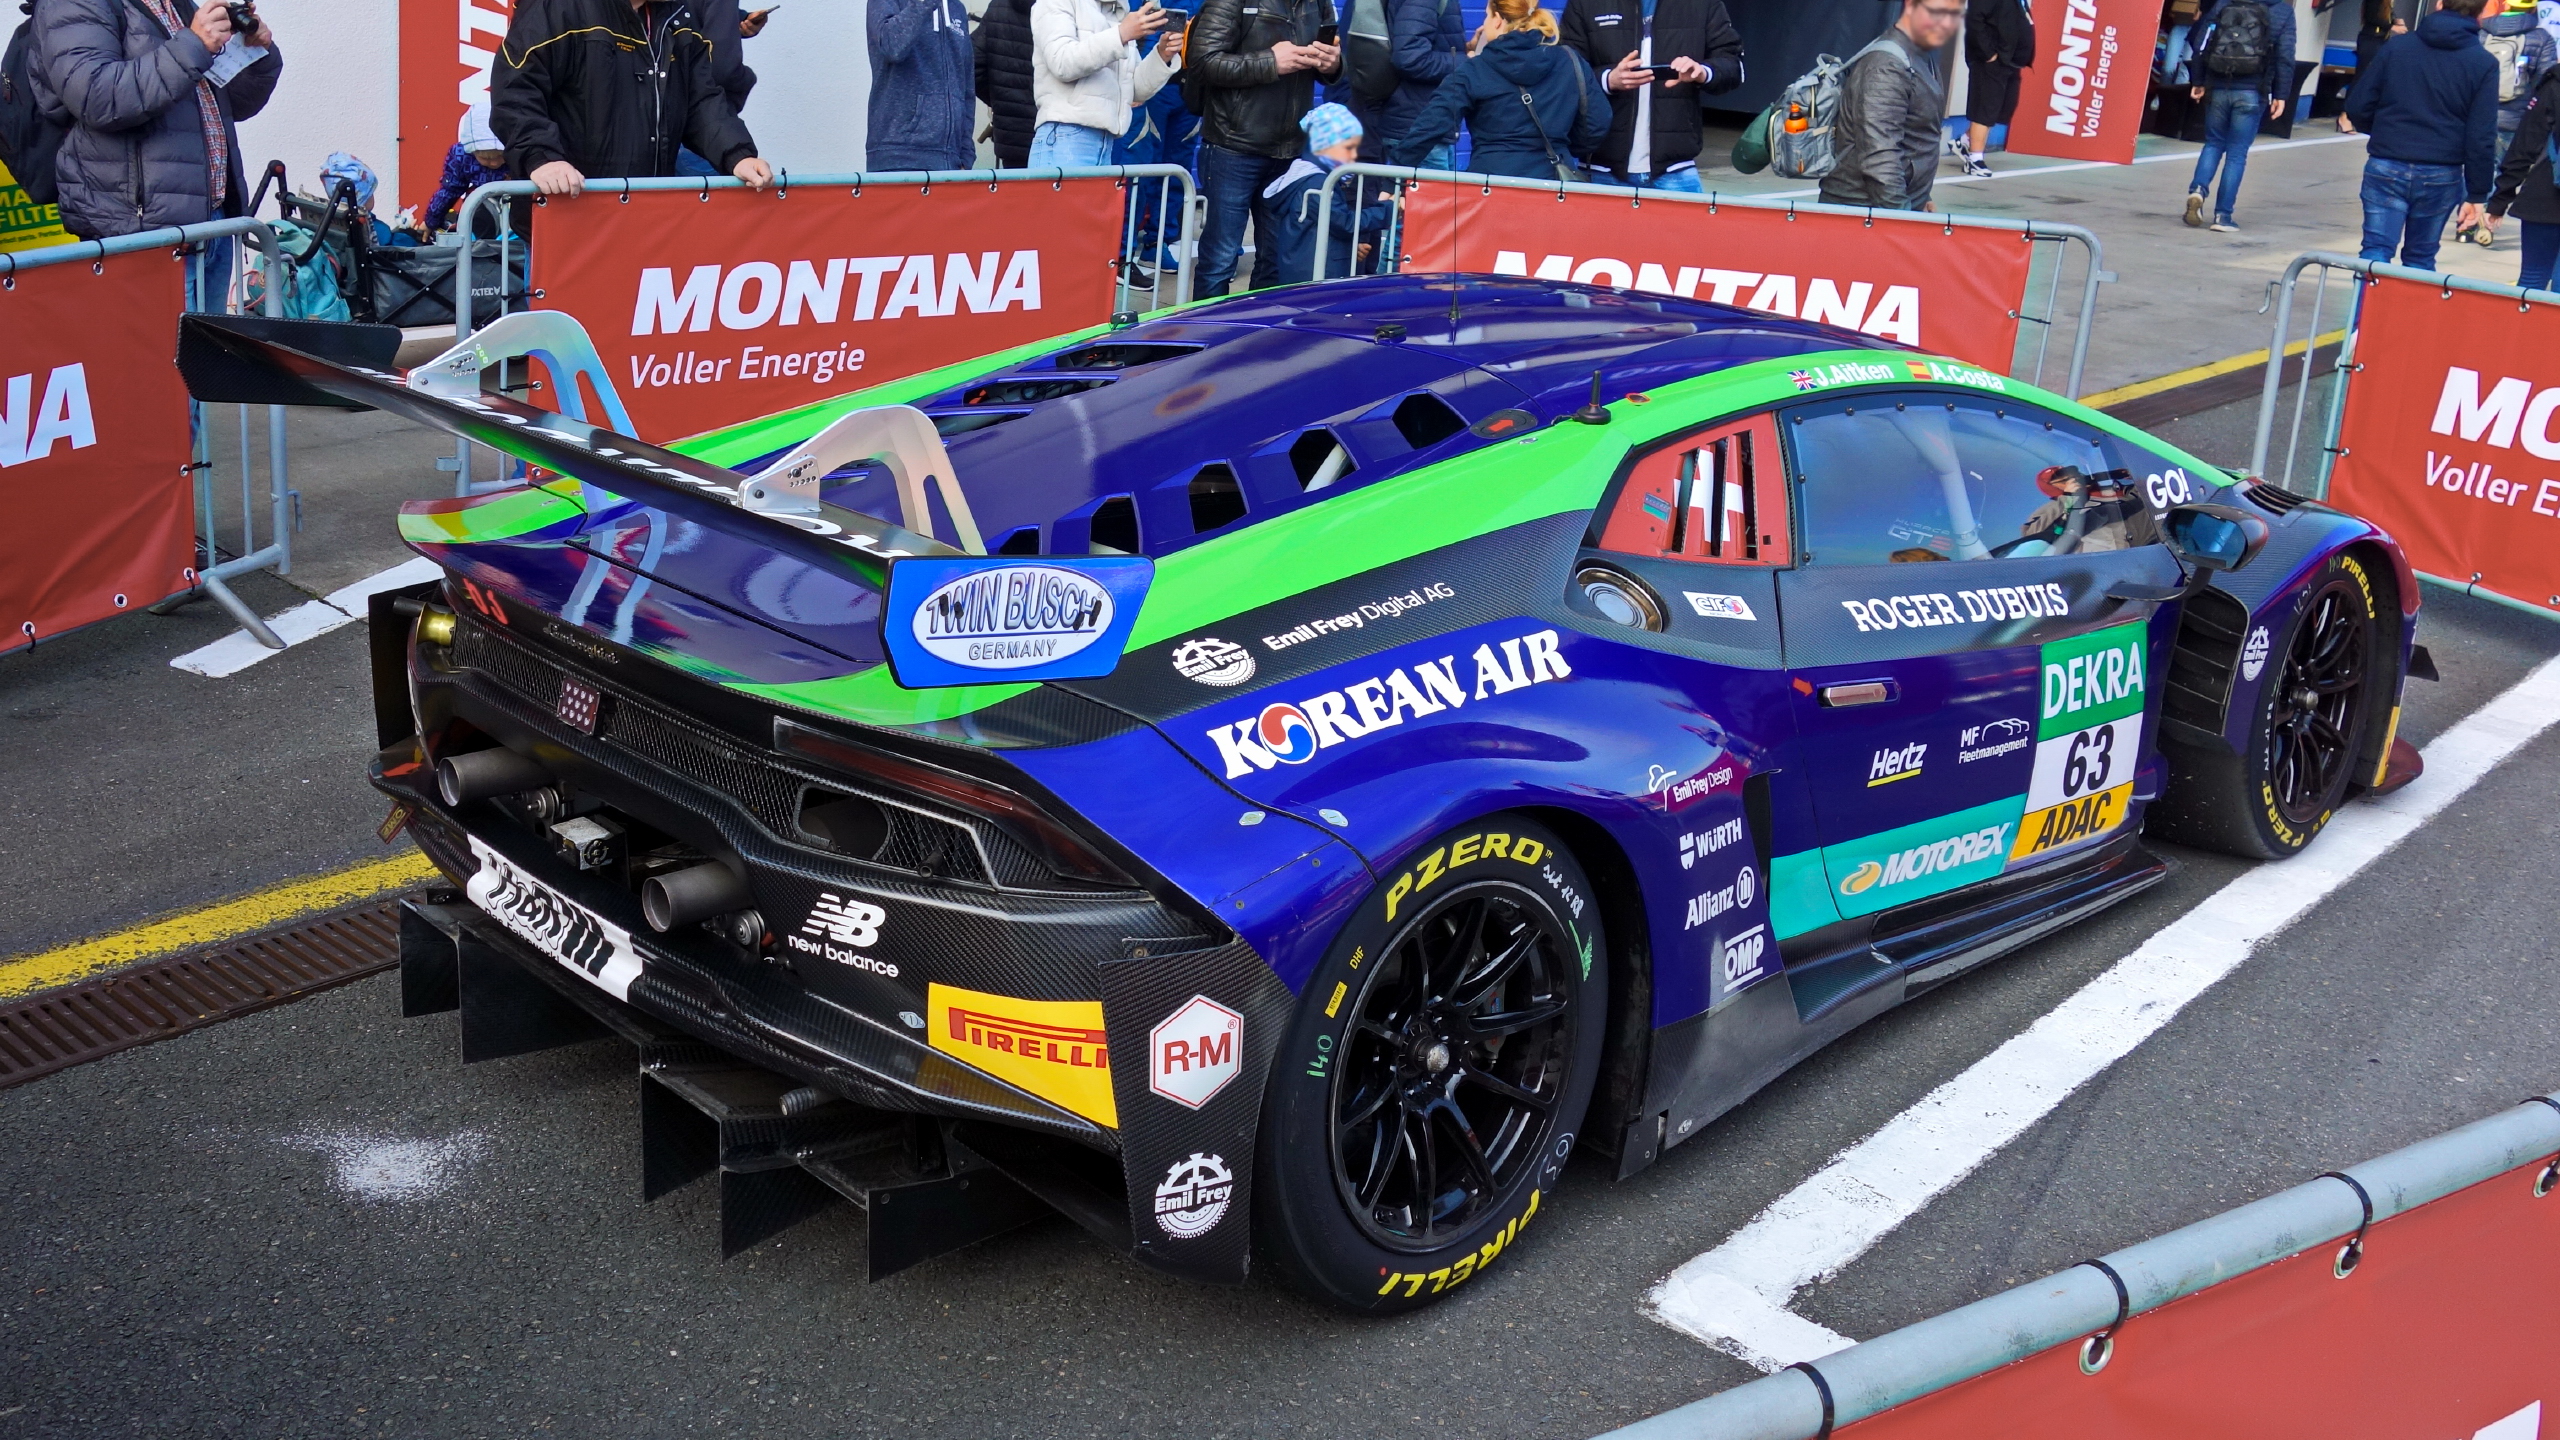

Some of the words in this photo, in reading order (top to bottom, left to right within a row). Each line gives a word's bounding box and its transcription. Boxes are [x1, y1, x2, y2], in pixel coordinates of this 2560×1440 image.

[2090, 25, 2119, 89] Energie
[2081, 90, 2104, 138] Voller
[630, 250, 1042, 337] MONTANA
[630, 350, 731, 389] Voller
[738, 342, 866, 384] Energie
[1816, 361, 1895, 388] J.Aitken
[1930, 361, 2005, 391] A.Costa
[2146, 467, 2193, 509] GO!
[2426, 450, 2529, 507] Voller
[926, 573, 1002, 634] TWIN
[1004, 571, 1103, 631] BUSCH
[1696, 596, 1725, 612] elf
[1841, 594, 1965, 632] ROGER
[1958, 583, 2070, 623] DUBUIS
[2341, 555, 2376, 619] PIRELLI
[1262, 622, 1317, 651] Emil
[1315, 610, 1365, 639] Frey
[1363, 589, 1426, 622] Digital
[1423, 582, 1455, 604] AG
[968, 639, 1058, 661] GERMANY
[1180, 658, 1217, 680] Emil
[1217, 646, 1251, 672] Frey
[2043, 641, 2144, 719] DEKRA
[1206, 655, 1467, 780] KOREAN
[1471, 628, 1572, 701] AIR
[1958, 735, 2029, 764] Fleetmanagement
[1961, 726, 1980, 748] MF
[2063, 724, 2114, 797] 63
[1673, 782, 1692, 803] Emil
[1692, 776, 1709, 796] Frey
[1708, 766, 1733, 788] Design
[1868, 742, 1928, 780] Hertz
[1695, 817, 1743, 859] WÜRTH
[2031, 792, 2112, 854] ADAC
[1880, 822, 2011, 888] MOTOREX
[1684, 884, 1735, 931] Allianz
[788, 933, 822, 956] new
[824, 942, 899, 979] balance
[1349, 945, 1364, 970] DHF
[1724, 933, 1764, 981] OMP
[948, 1006, 1109, 1069] PIRELLI
[1163, 1031, 1232, 1075] R-M
[1307, 1034, 1333, 1078] 140
[1154, 1190, 1193, 1214] Emil
[1196, 1184, 1233, 1205] Frey
[1378, 1189, 1541, 1298] PIRELLI
